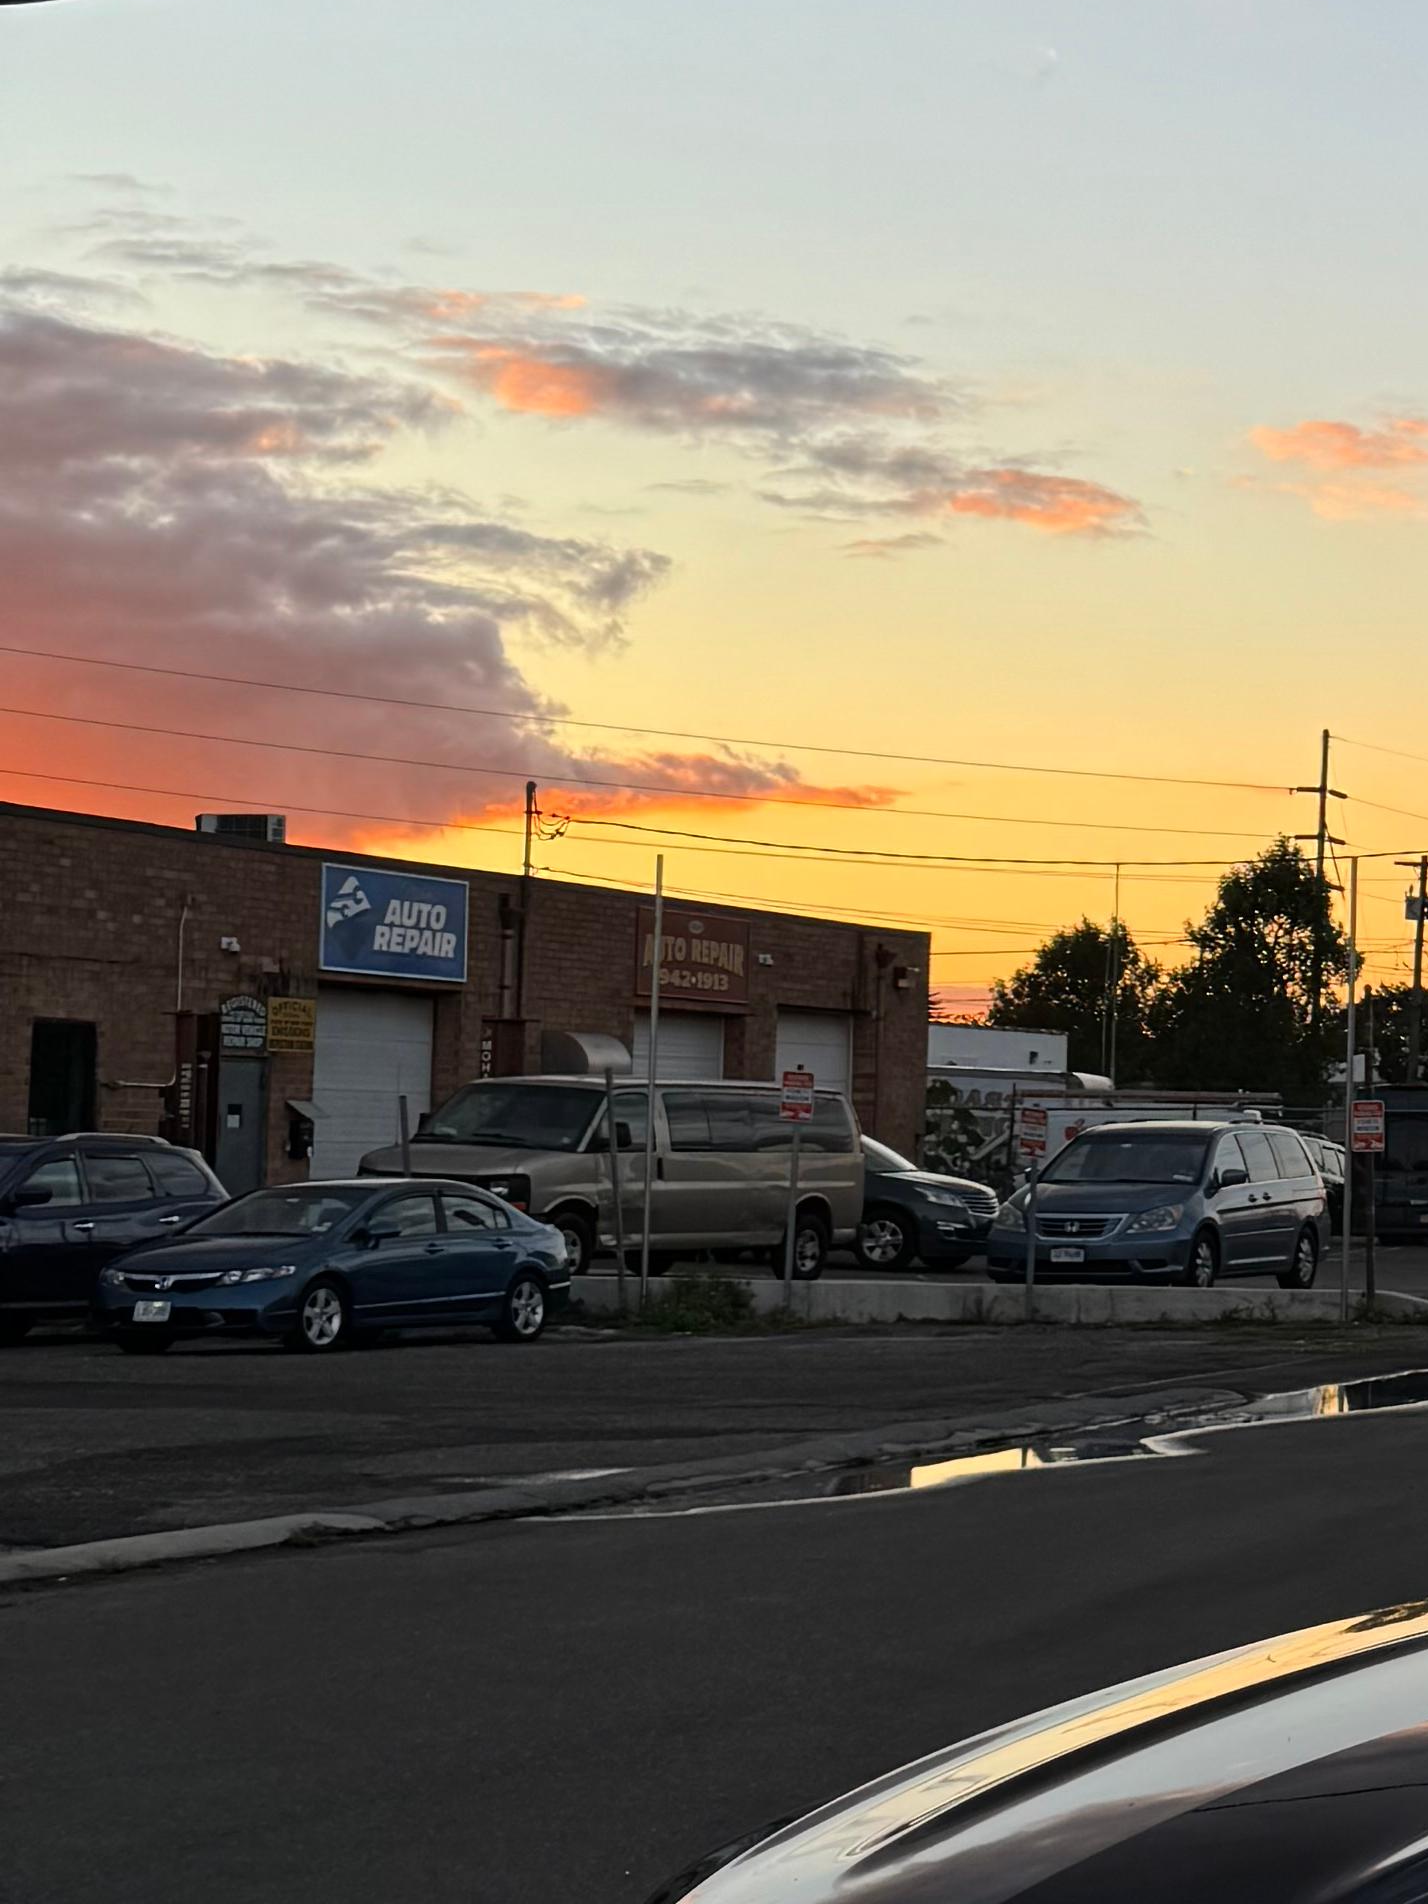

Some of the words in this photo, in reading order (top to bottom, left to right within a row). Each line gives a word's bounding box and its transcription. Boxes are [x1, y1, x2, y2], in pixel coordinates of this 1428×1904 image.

[384, 899, 447, 930] AUTO
[373, 925, 457, 958] REPAIR
[691, 938, 745, 978] REPAIR
